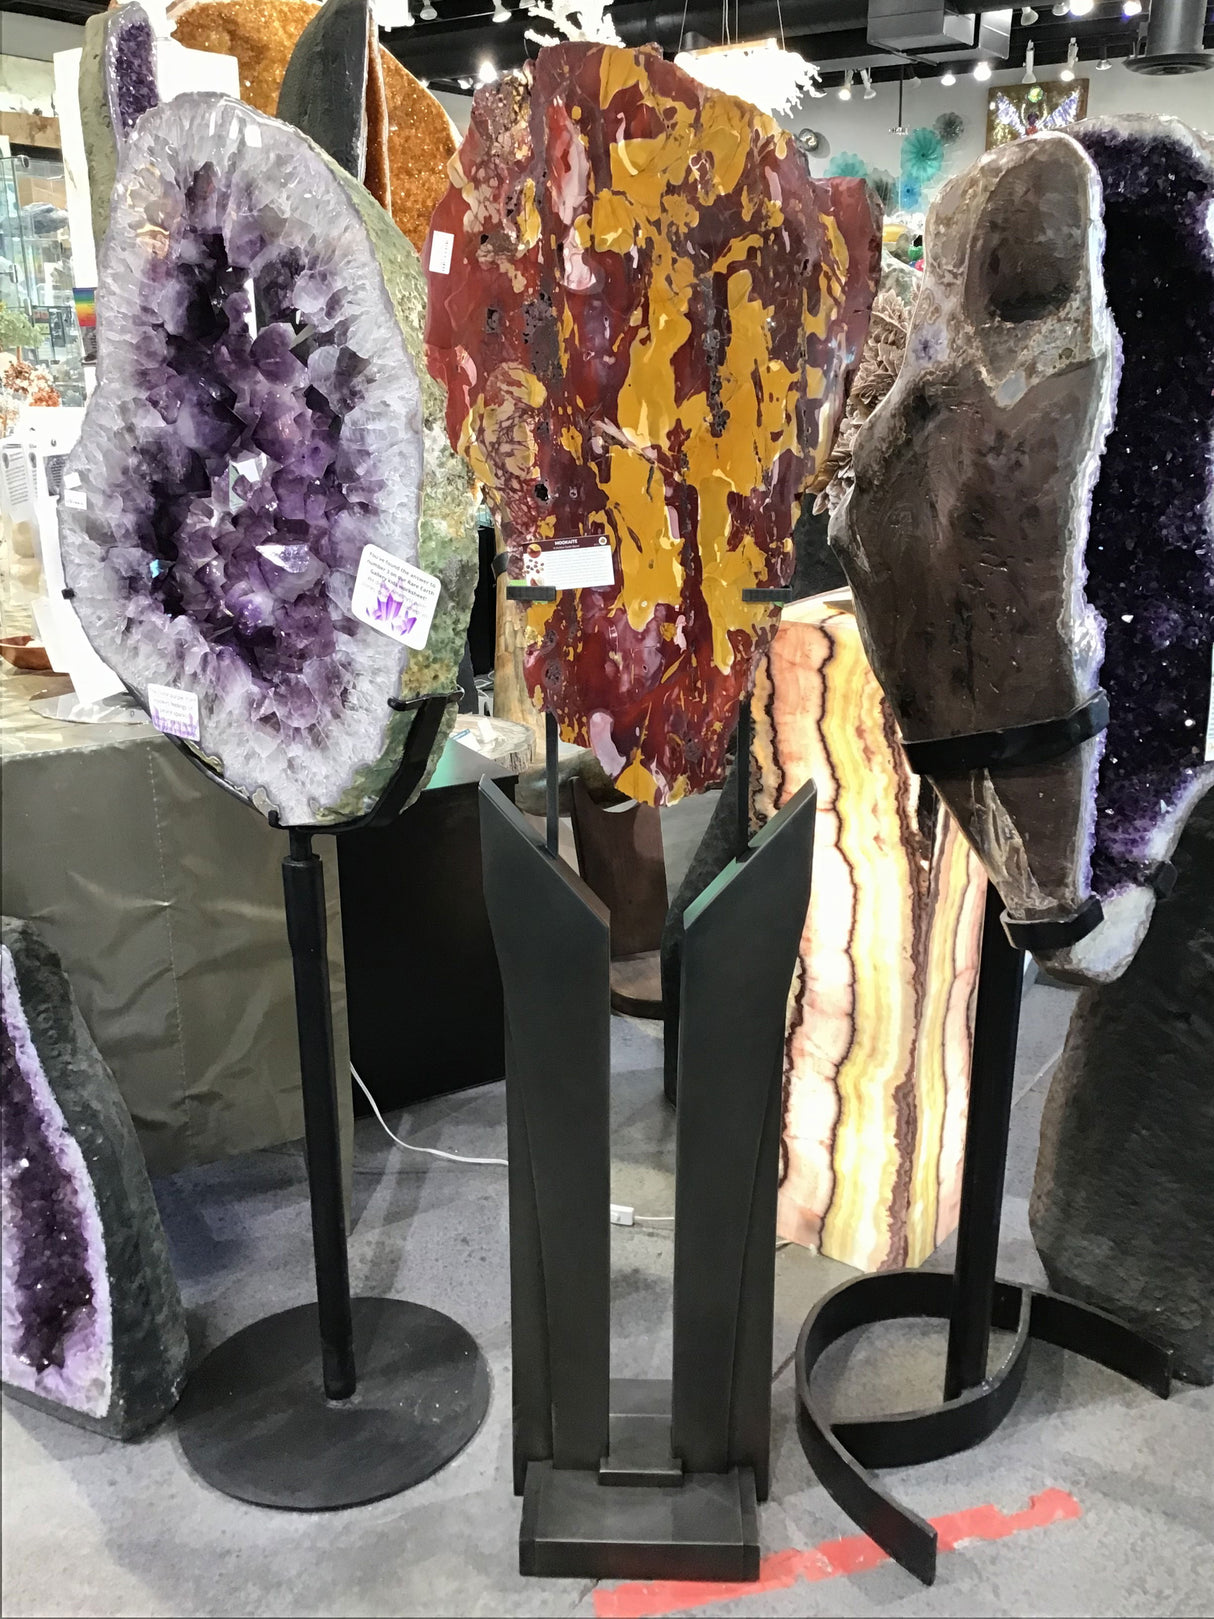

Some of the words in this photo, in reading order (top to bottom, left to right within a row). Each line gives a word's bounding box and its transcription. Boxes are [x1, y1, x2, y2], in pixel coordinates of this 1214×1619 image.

[367, 559, 386, 571] number
[407, 580, 419, 588] Rare
[419, 586, 435, 596] Earth
[369, 551, 385, 562] You've
[385, 559, 400, 571] found
[400, 568, 409, 576] the
[410, 574, 429, 585] answer
[370, 568, 387, 581] Gallery
